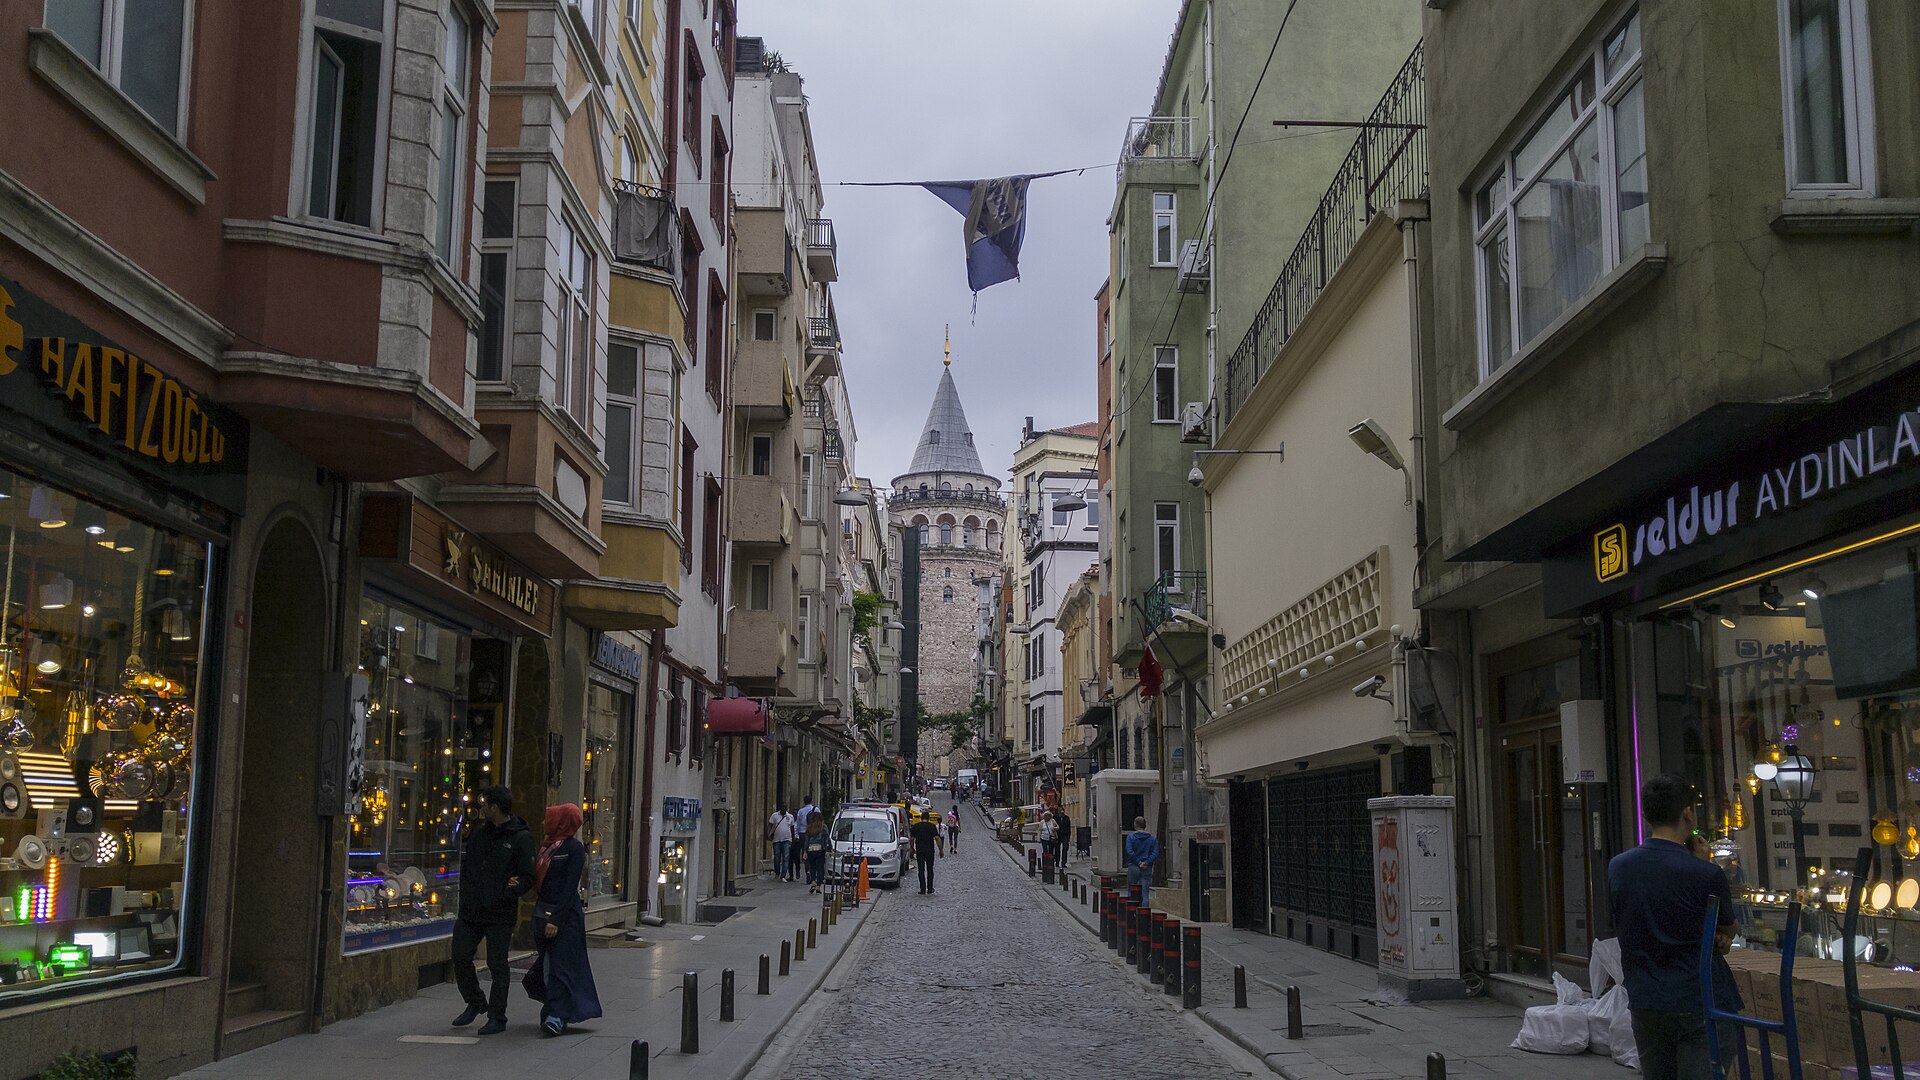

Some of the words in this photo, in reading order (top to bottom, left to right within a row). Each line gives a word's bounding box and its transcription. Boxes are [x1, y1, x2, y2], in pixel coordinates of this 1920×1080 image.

[41, 336, 224, 464] HAFIZOĞLU
[1633, 482, 1739, 566] seldur
[1755, 406, 1920, 518] AYDINLA
